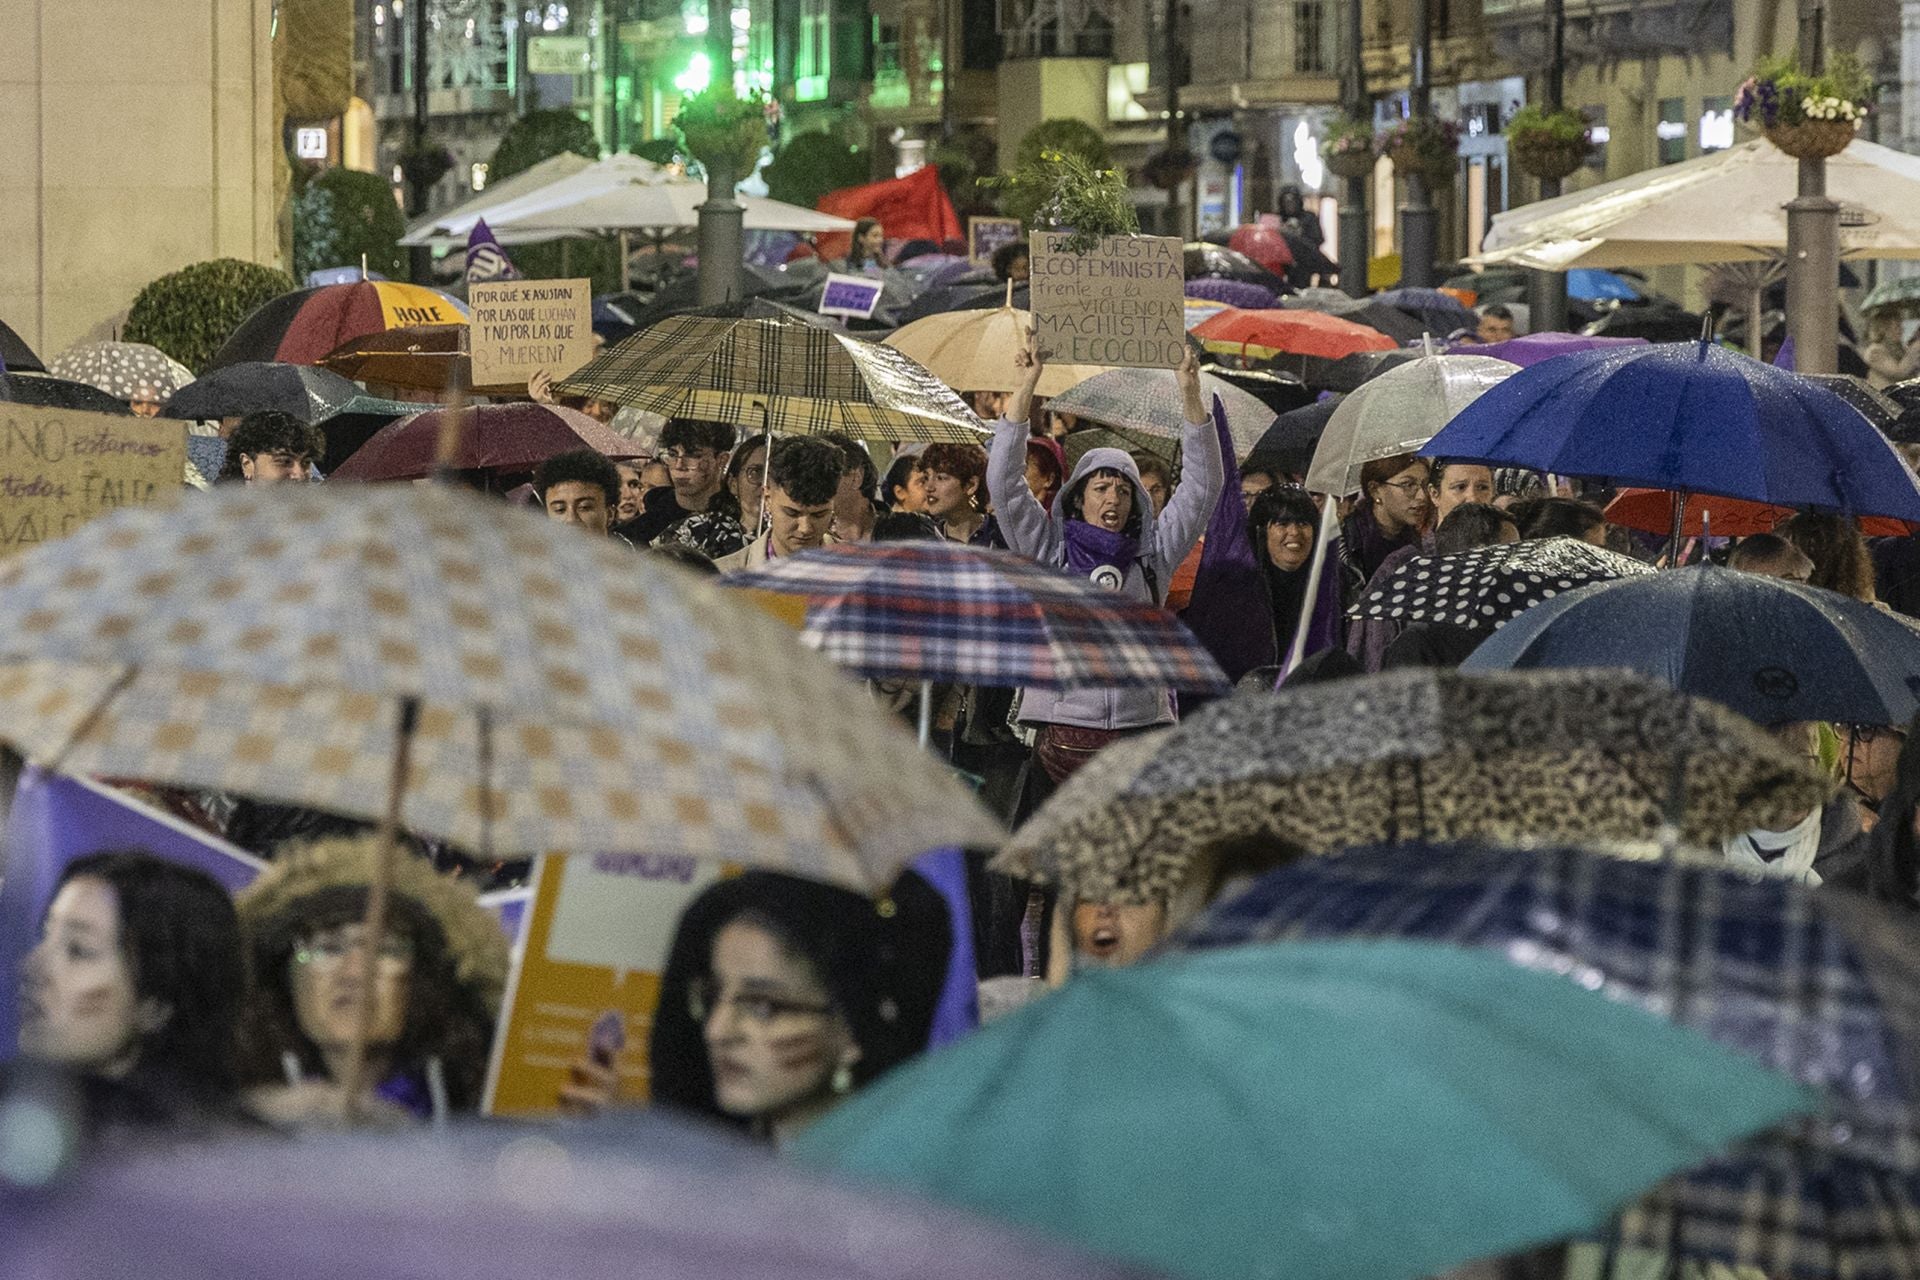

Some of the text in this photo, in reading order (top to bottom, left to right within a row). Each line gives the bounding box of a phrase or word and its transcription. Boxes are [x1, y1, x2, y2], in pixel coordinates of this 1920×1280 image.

[1032, 256, 1181, 280] ECOFEMINISTA
[521, 289, 531, 302] SE
[532, 288, 573, 301] ASUSTAN
[1038, 277, 1142, 297] frente a la
[477, 308, 576, 322] POR LAS QUE LUCHAN
[1078, 298, 1180, 317] VIOLENCIA
[483, 325, 574, 341] Y NO POR LAS QUE
[1035, 313, 1173, 337] MACHISTA
[500, 343, 565, 364] MUEREN?
[1073, 336, 1185, 365] ECOCIDIO
[6, 418, 66, 462] NO
